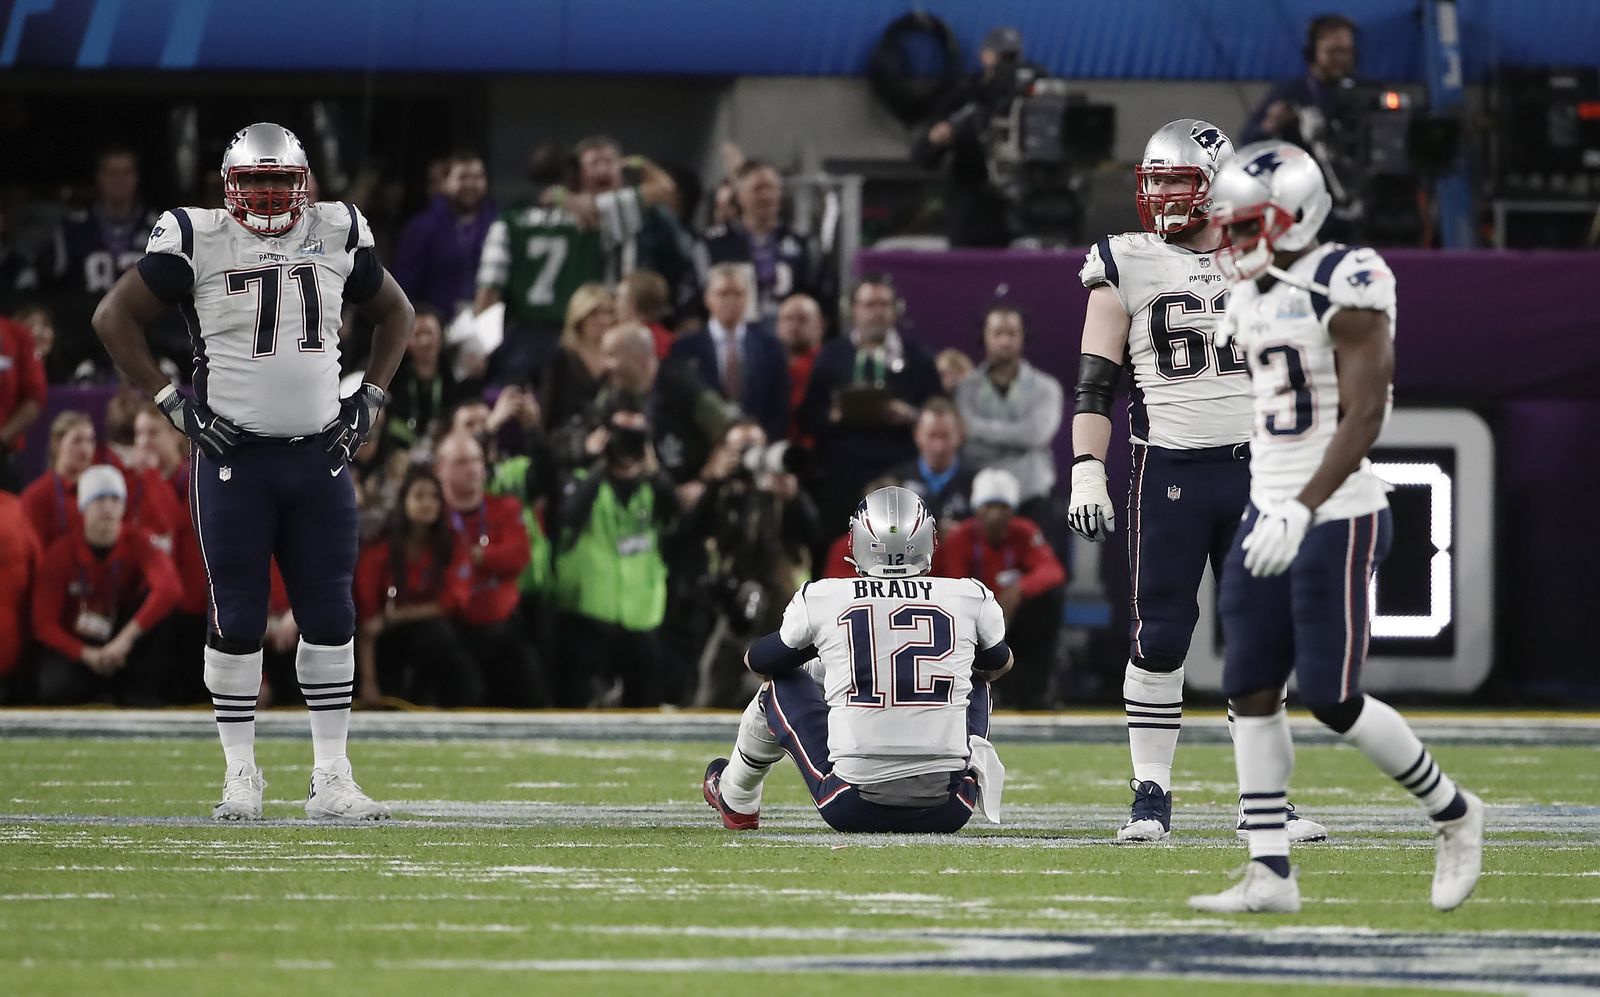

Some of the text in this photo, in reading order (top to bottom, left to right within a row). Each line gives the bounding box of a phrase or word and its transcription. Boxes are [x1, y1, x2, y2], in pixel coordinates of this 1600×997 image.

[259, 253, 289, 261] PATRIOTS
[526, 236, 568, 305] 7
[1189, 274, 1221, 283] PATRIOTS
[224, 263, 325, 358] 71
[1254, 340, 1319, 442] 3
[887, 553, 905, 566] 12
[852, 579, 933, 600] BRADY
[837, 603, 955, 708] 12
